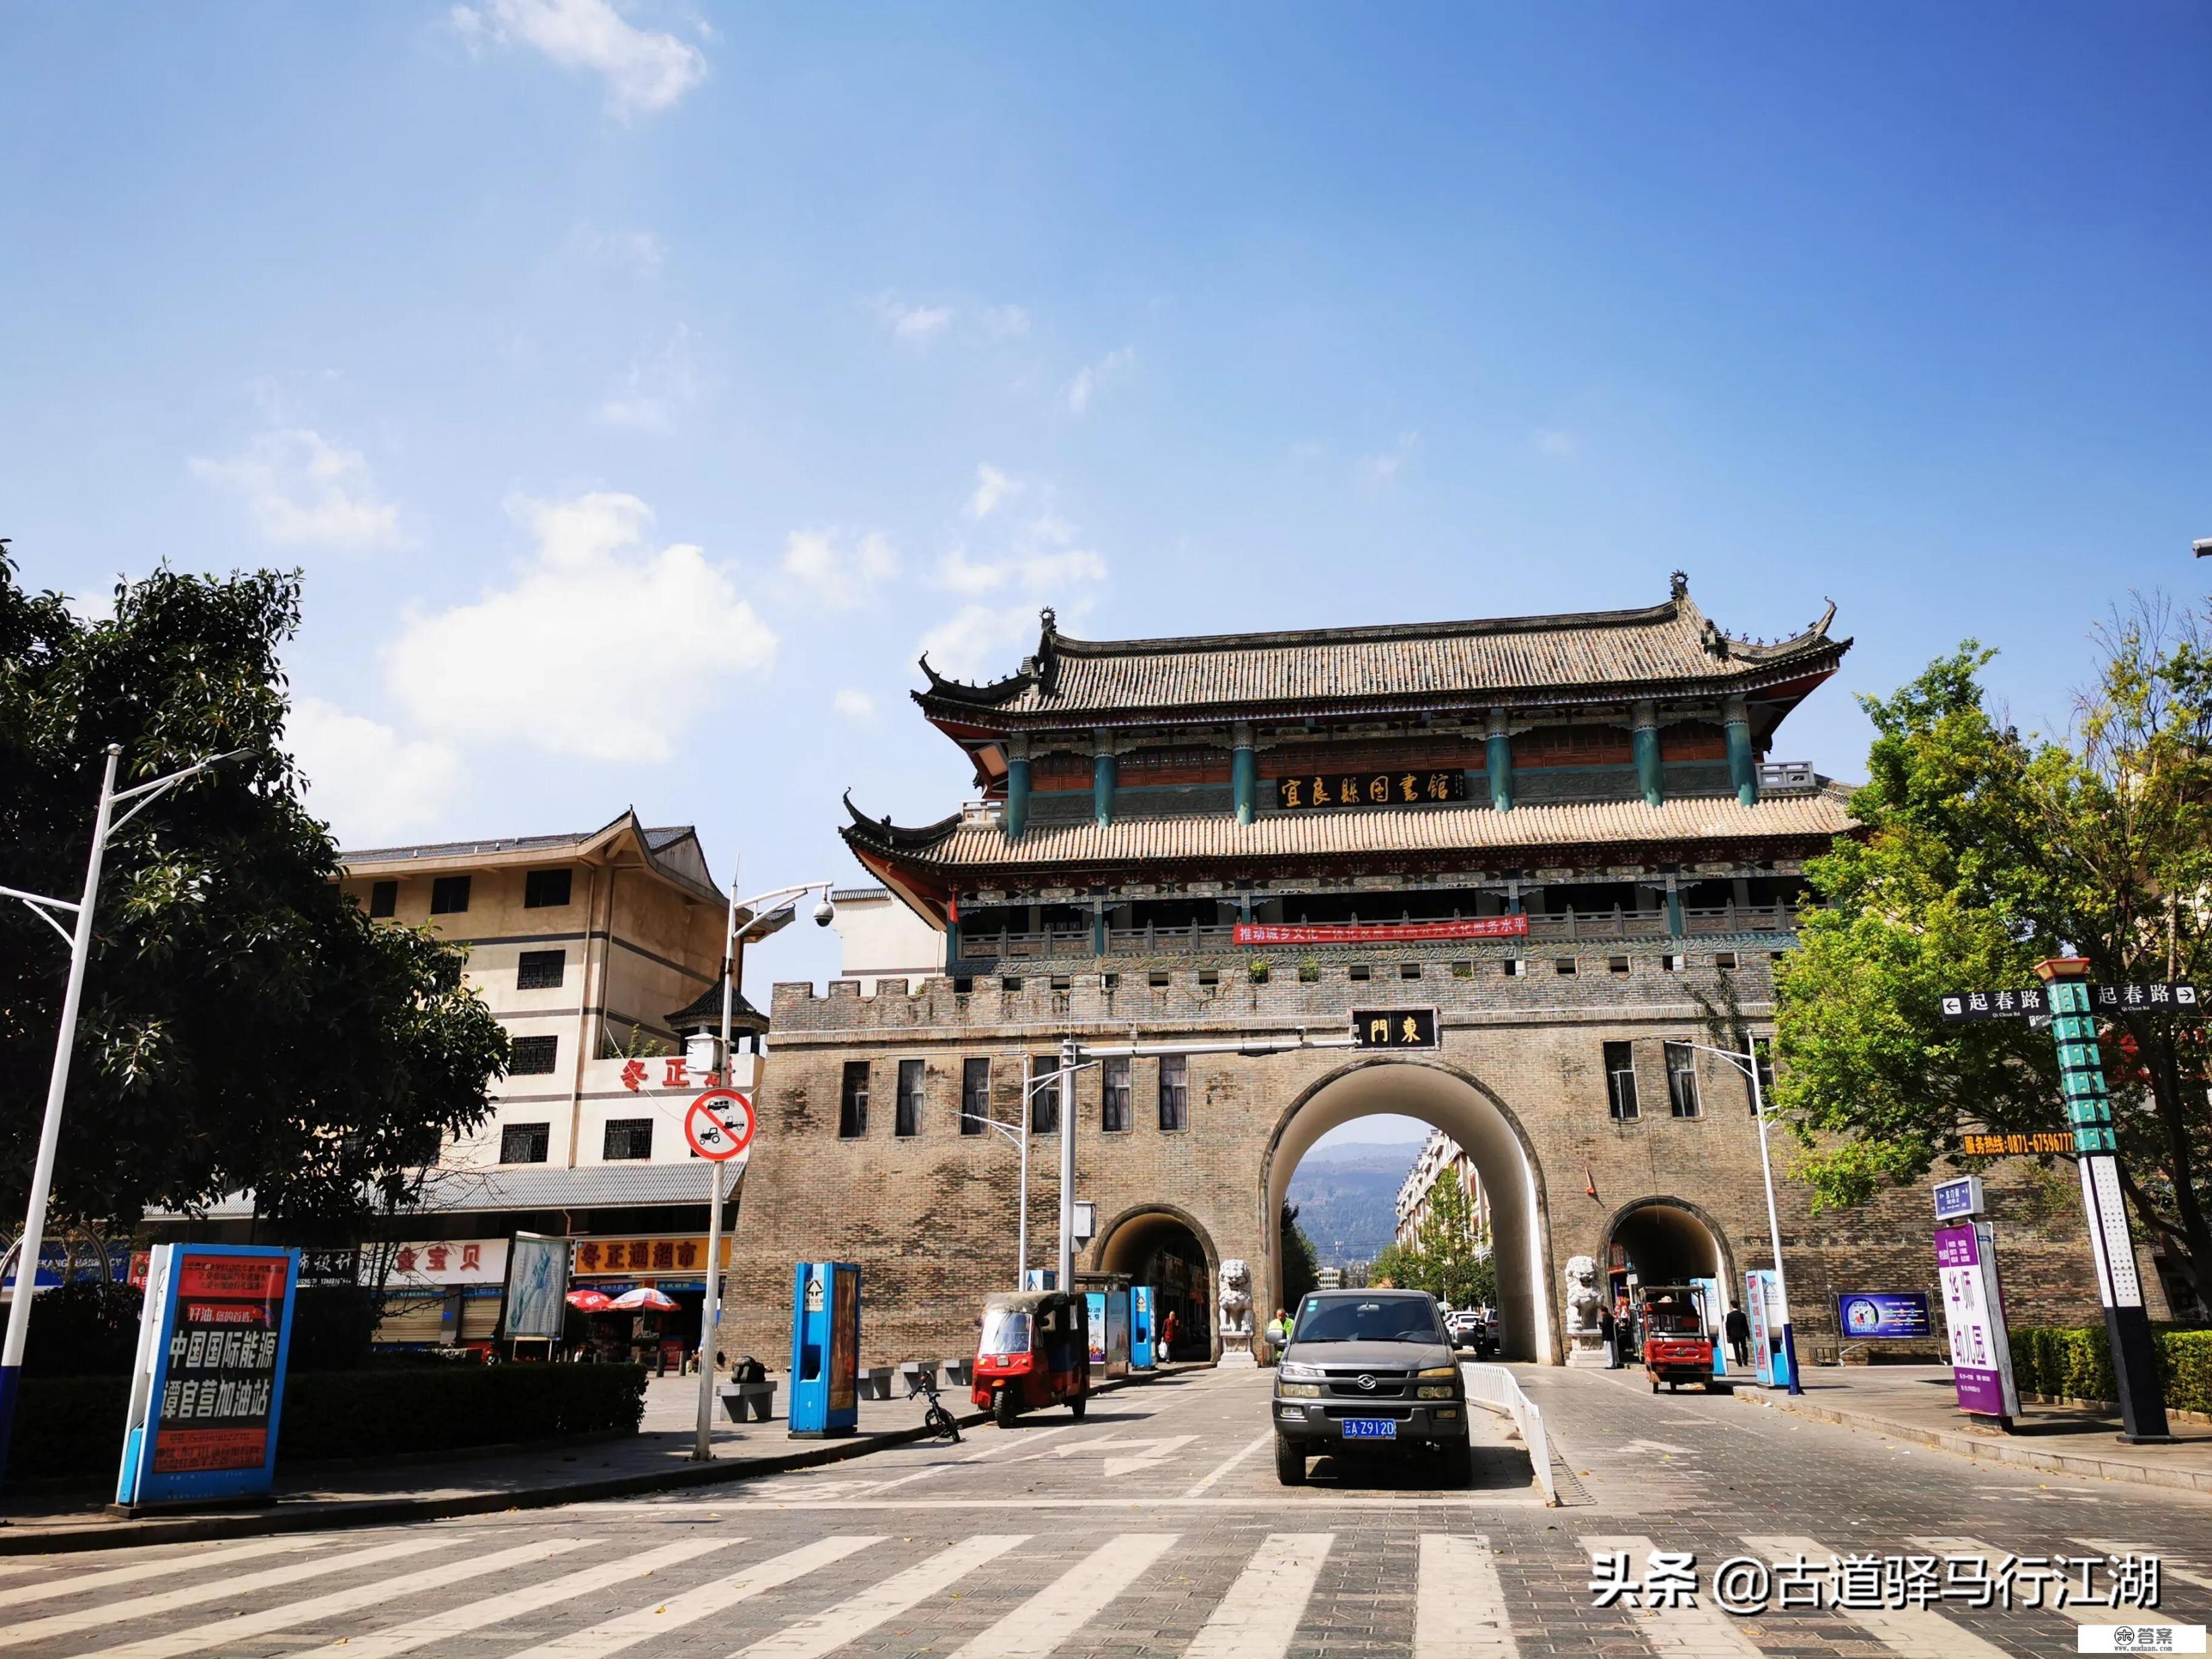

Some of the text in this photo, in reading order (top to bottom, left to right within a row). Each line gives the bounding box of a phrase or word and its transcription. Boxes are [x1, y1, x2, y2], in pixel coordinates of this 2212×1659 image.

[1968, 989, 2041, 1011] 起春路
[2097, 983, 2170, 1005] 起春路
[581, 1241, 697, 1269] 冬正通超市
[170, 1329, 277, 1369] 中国国际能源
[1953, 1323, 1986, 1366] 幼儿园
